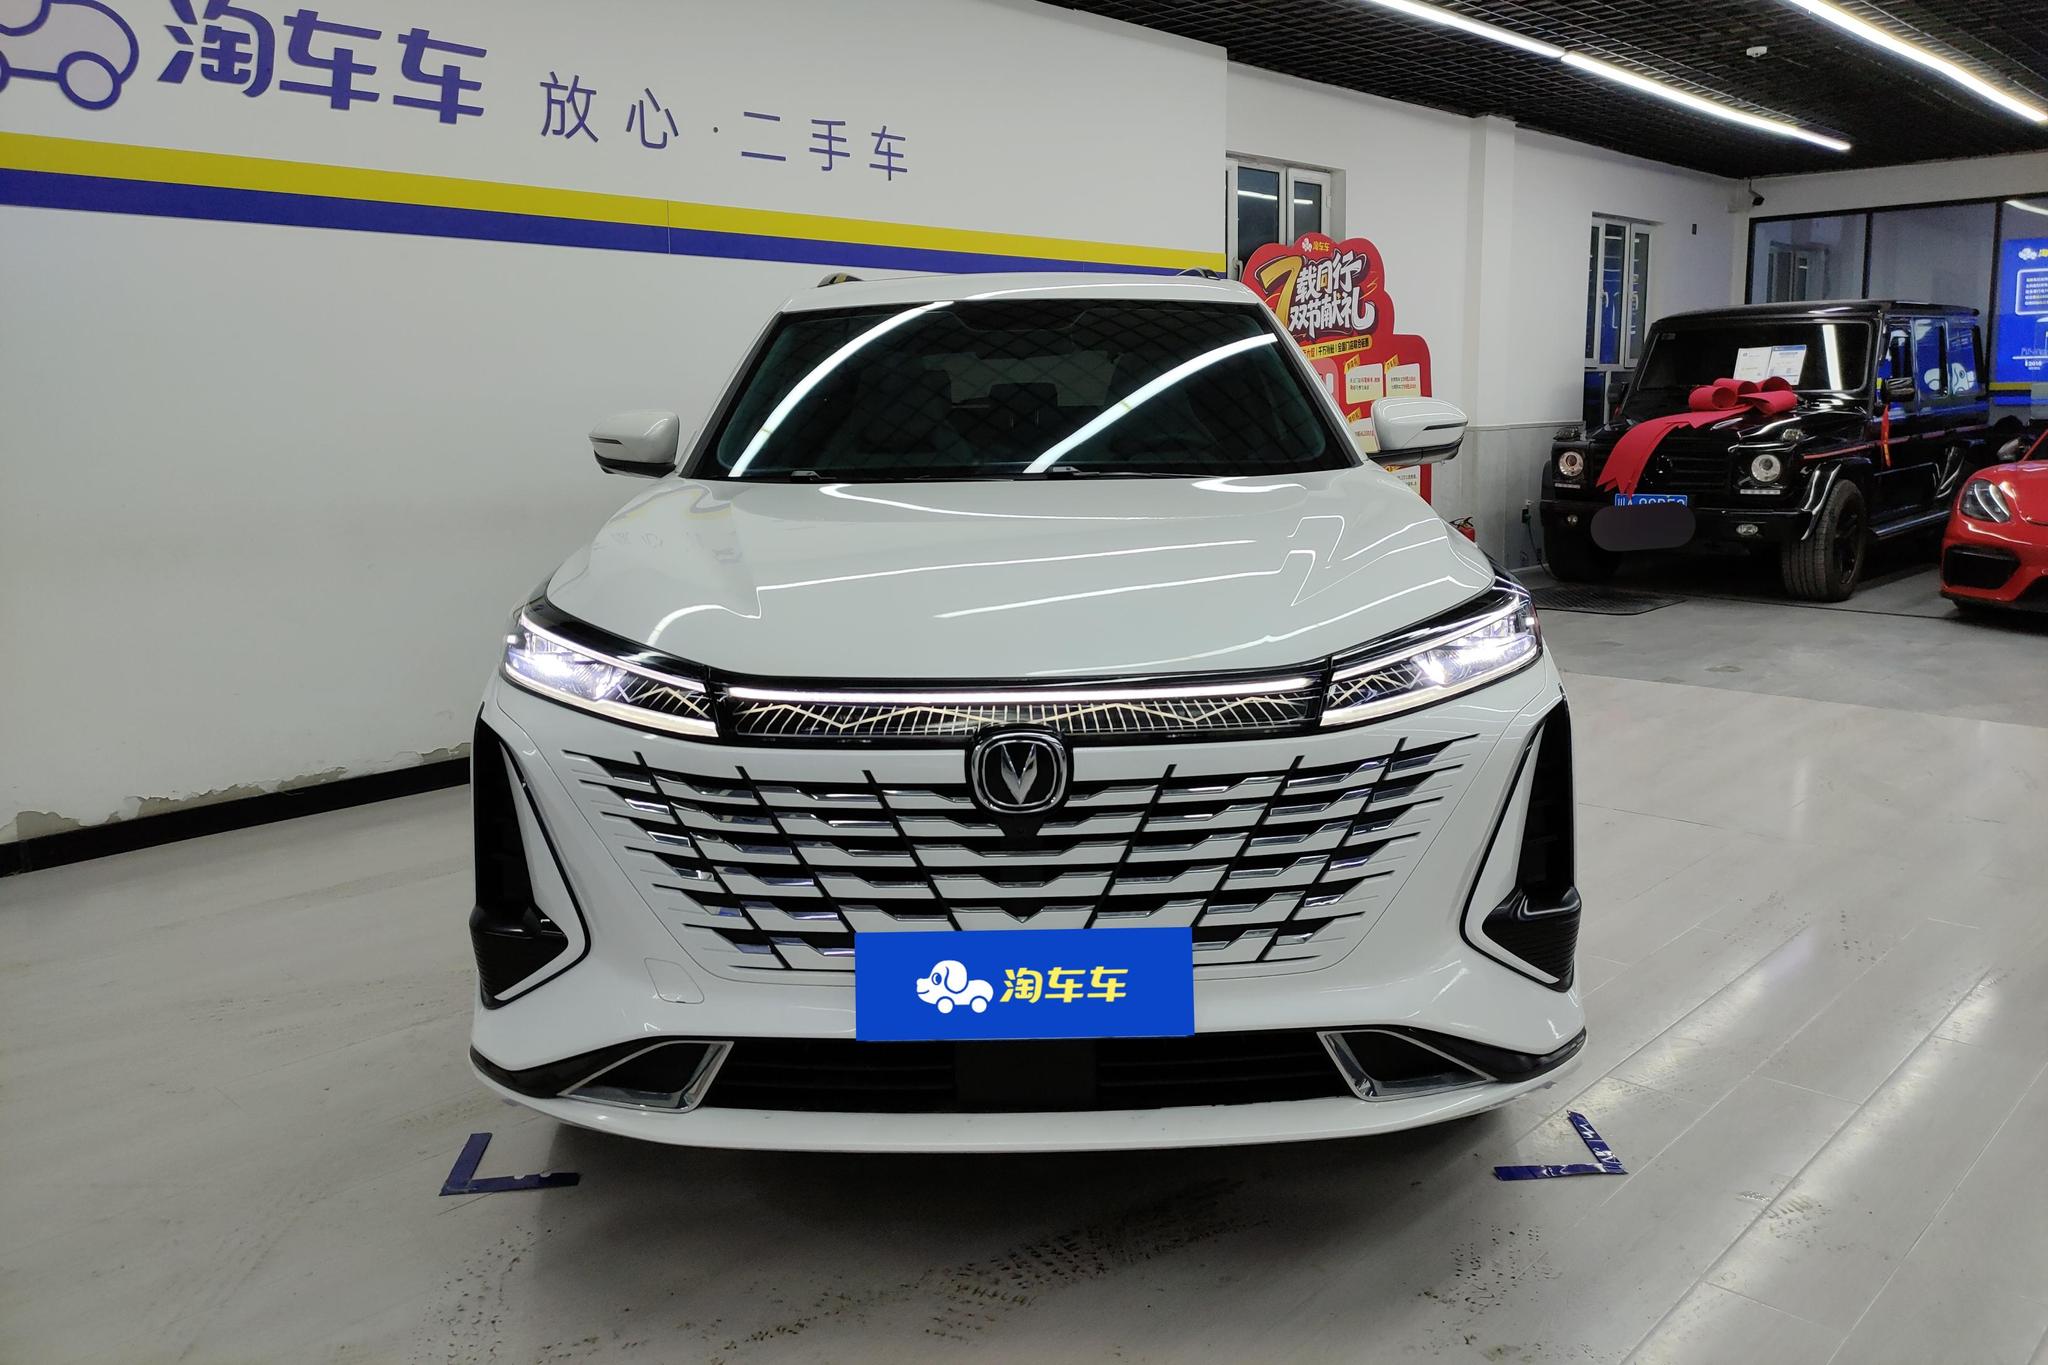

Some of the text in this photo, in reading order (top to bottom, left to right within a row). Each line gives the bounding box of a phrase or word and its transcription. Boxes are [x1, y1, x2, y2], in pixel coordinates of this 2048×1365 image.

[157, 0, 487, 125] 淘车车
[1287, 286, 1376, 339] 双节献礼
